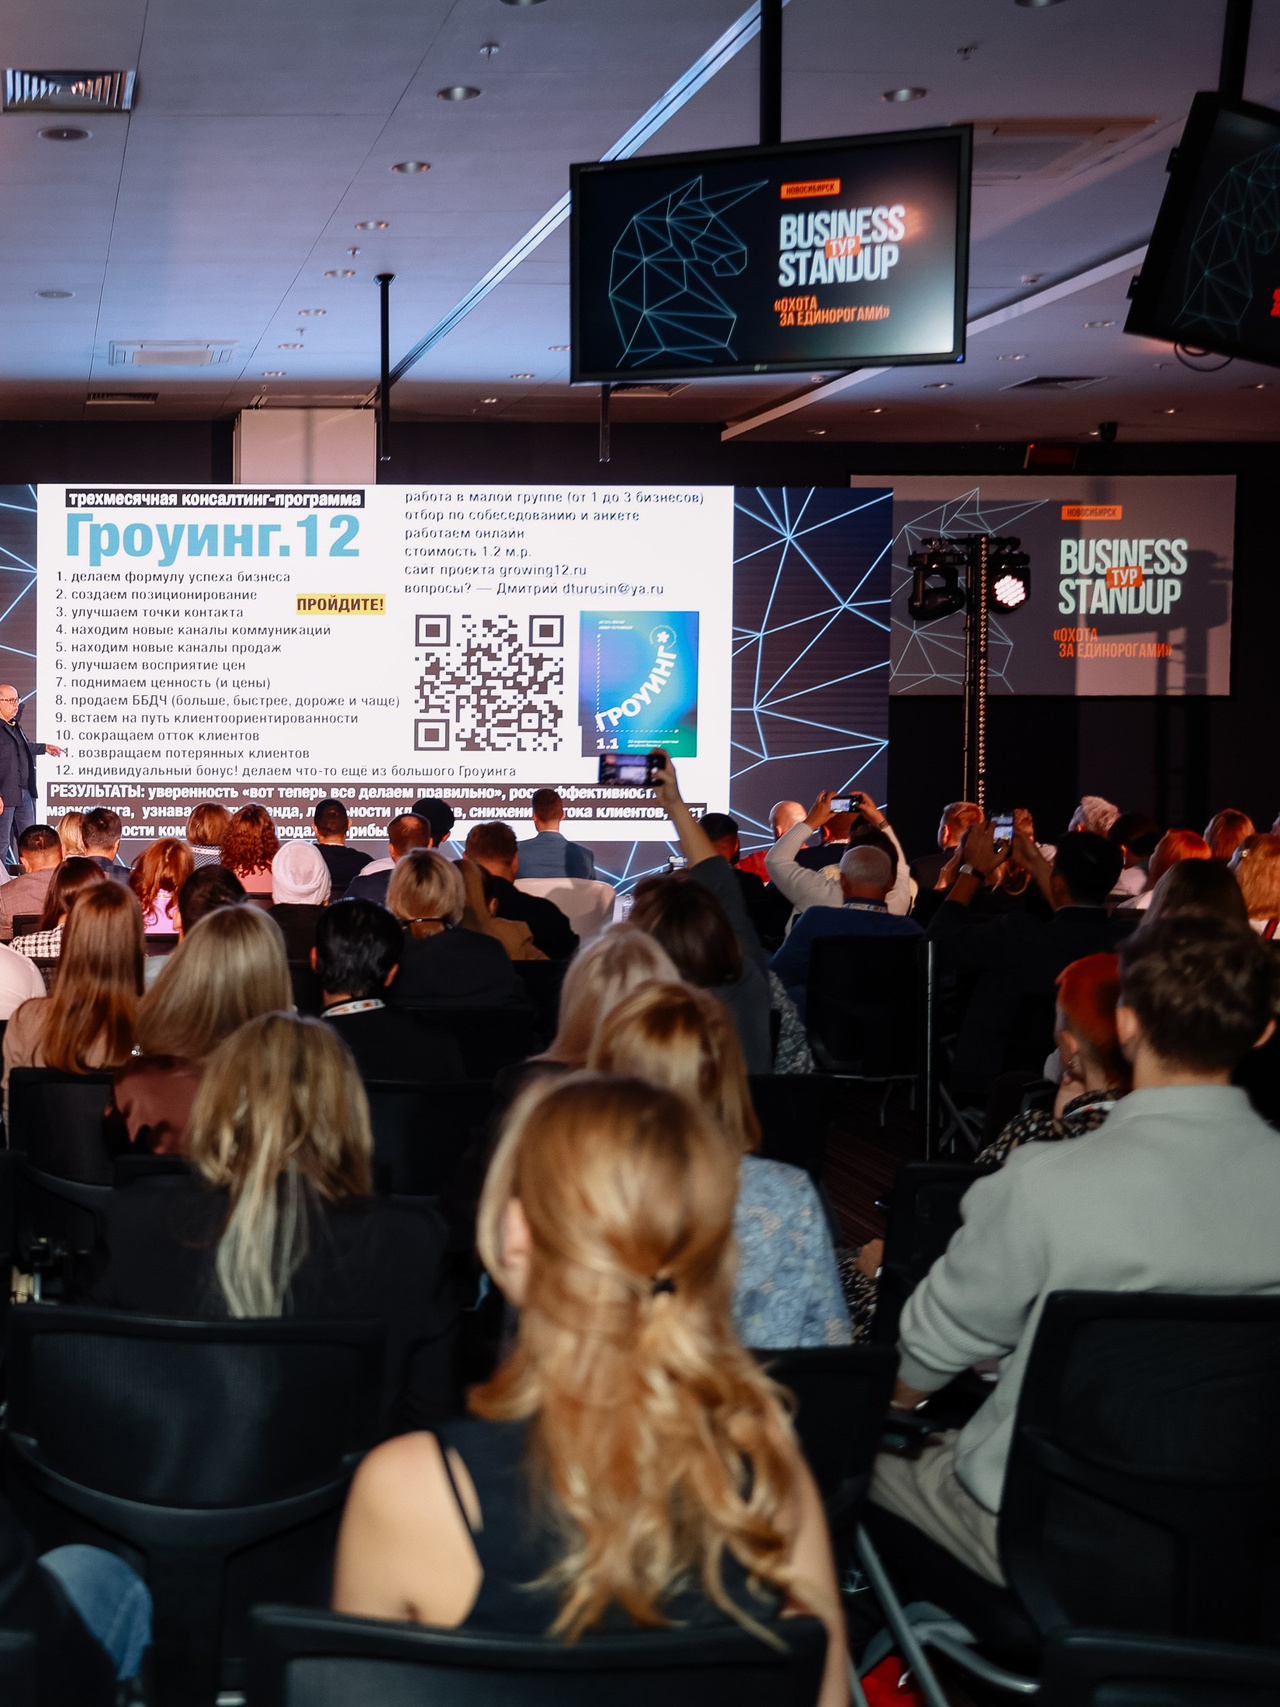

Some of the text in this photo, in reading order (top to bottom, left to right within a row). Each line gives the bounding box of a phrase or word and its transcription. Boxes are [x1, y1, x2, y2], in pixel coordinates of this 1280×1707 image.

[786, 182, 835, 194] НОВОСИБИРСК
[779, 204, 906, 251] BUSINESS
[829, 238, 856, 256] ТУР
[778, 243, 900, 288] STANDUP
[774, 295, 818, 312] «ОХОТА
[779, 304, 890, 327] ЗА ЕДИНОРОГАМИ»
[69, 492, 362, 508] трехмесячная консалтинг-программа
[406, 490, 703, 504] работа в малой группе (от 1 до 3 бизнесов)
[406, 508, 639, 522] отбор по собеседованию и анкете
[1066, 508, 1117, 518] НОВОСИБИРСК
[67, 513, 360, 567] Гроуинг.12
[406, 527, 524, 540] работаем онлайн
[405, 545, 531, 559] стоимость 1.2 м.р.
[1060, 539, 1188, 575] BUSINESS
[58, 570, 290, 584] 1. делаем формулу успеха бизнеса
[405, 564, 586, 577] сайт проекта growing12.ru
[1111, 569, 1139, 586] ТУР
[56, 588, 256, 602] 2. создаем позиционирование
[405, 583, 471, 595] вопросы?
[497, 582, 558, 595] Дмитрий
[563, 582, 664, 596] dturusin@ya.ru
[297, 595, 384, 613] ПРОЙДИТЕ!
[1058, 579, 1181, 615] STANDUP
[56, 606, 243, 619] 3. улучшаем точки контакта
[56, 623, 330, 637] 4. находим новые каналы коммуникаций
[1053, 628, 1099, 642] «ОХОТА
[56, 641, 281, 654] 5. находим новые каналы продаж
[1059, 643, 1172, 658] ЗА ЕДИНОРОГАМИ»
[56, 658, 245, 672] 6. улучшаем восприятие цен
[56, 676, 270, 690] 7. поднимаем ценность (и цены)
[595, 645, 677, 732] ГРОУИНГ
[56, 694, 399, 708] 8. продаем ББДЧ (больше, быстрее, дороже и чаще)
[56, 711, 357, 725] 9. встаем на путь клиентоориентированности
[57, 729, 259, 742] 10. сокращаем отток клиентов
[596, 737, 619, 750] 1.1
[79, 749, 161, 760] возвращаем
[166, 749, 243, 760] потерянных
[249, 749, 309, 759] клиентов
[57, 764, 515, 778] 12. индивидуальный бонус! делаем что-то ещё из большого Гроуинга
[51, 784, 144, 797] РЕЗУЛЬТАТЫ:
[148, 787, 238, 800] уверенность
[243, 787, 274, 797] «вот
[278, 787, 326, 800] теперь
[331, 787, 355, 798] все
[359, 787, 413, 800] делаем
[418, 787, 505, 800] правильно»,
[266, 806, 303, 819] енда,
[469, 807, 533, 818] снижени
[596, 807, 669, 821] клиентов,
